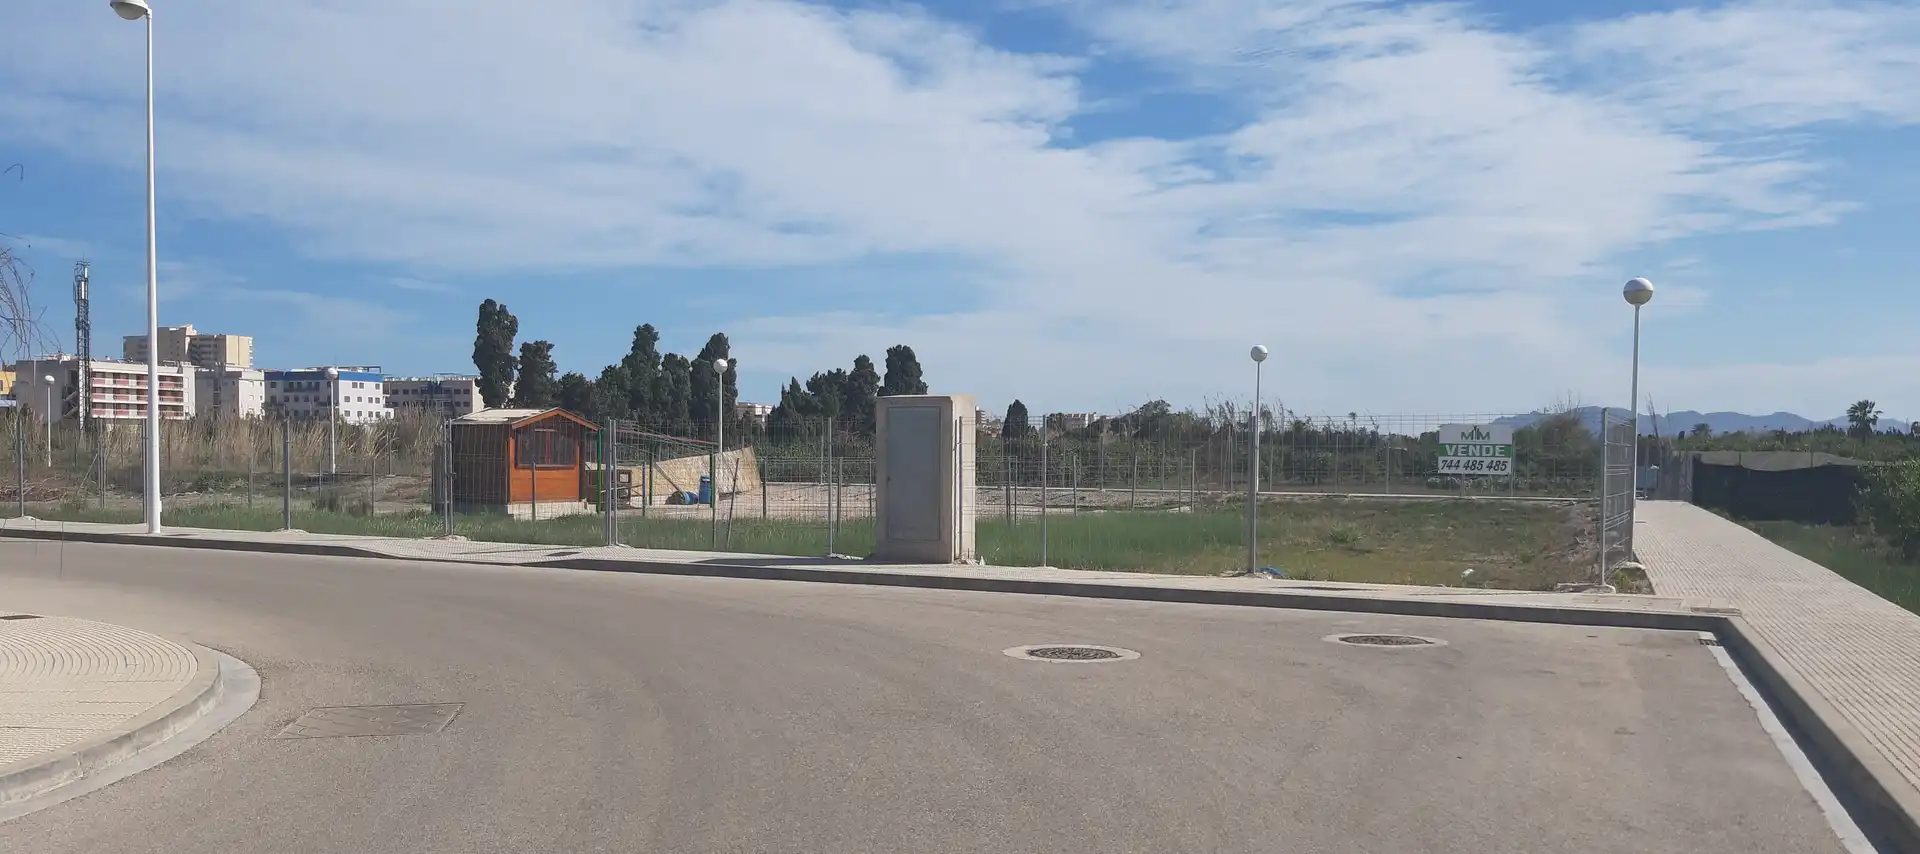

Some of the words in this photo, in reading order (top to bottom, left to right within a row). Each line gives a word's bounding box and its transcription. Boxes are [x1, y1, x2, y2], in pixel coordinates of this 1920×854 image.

[1445, 444, 1505, 457] VENDE
[1441, 460, 1460, 470] 744
[1463, 460, 1484, 471] 485
[1486, 460, 1508, 471] 485
